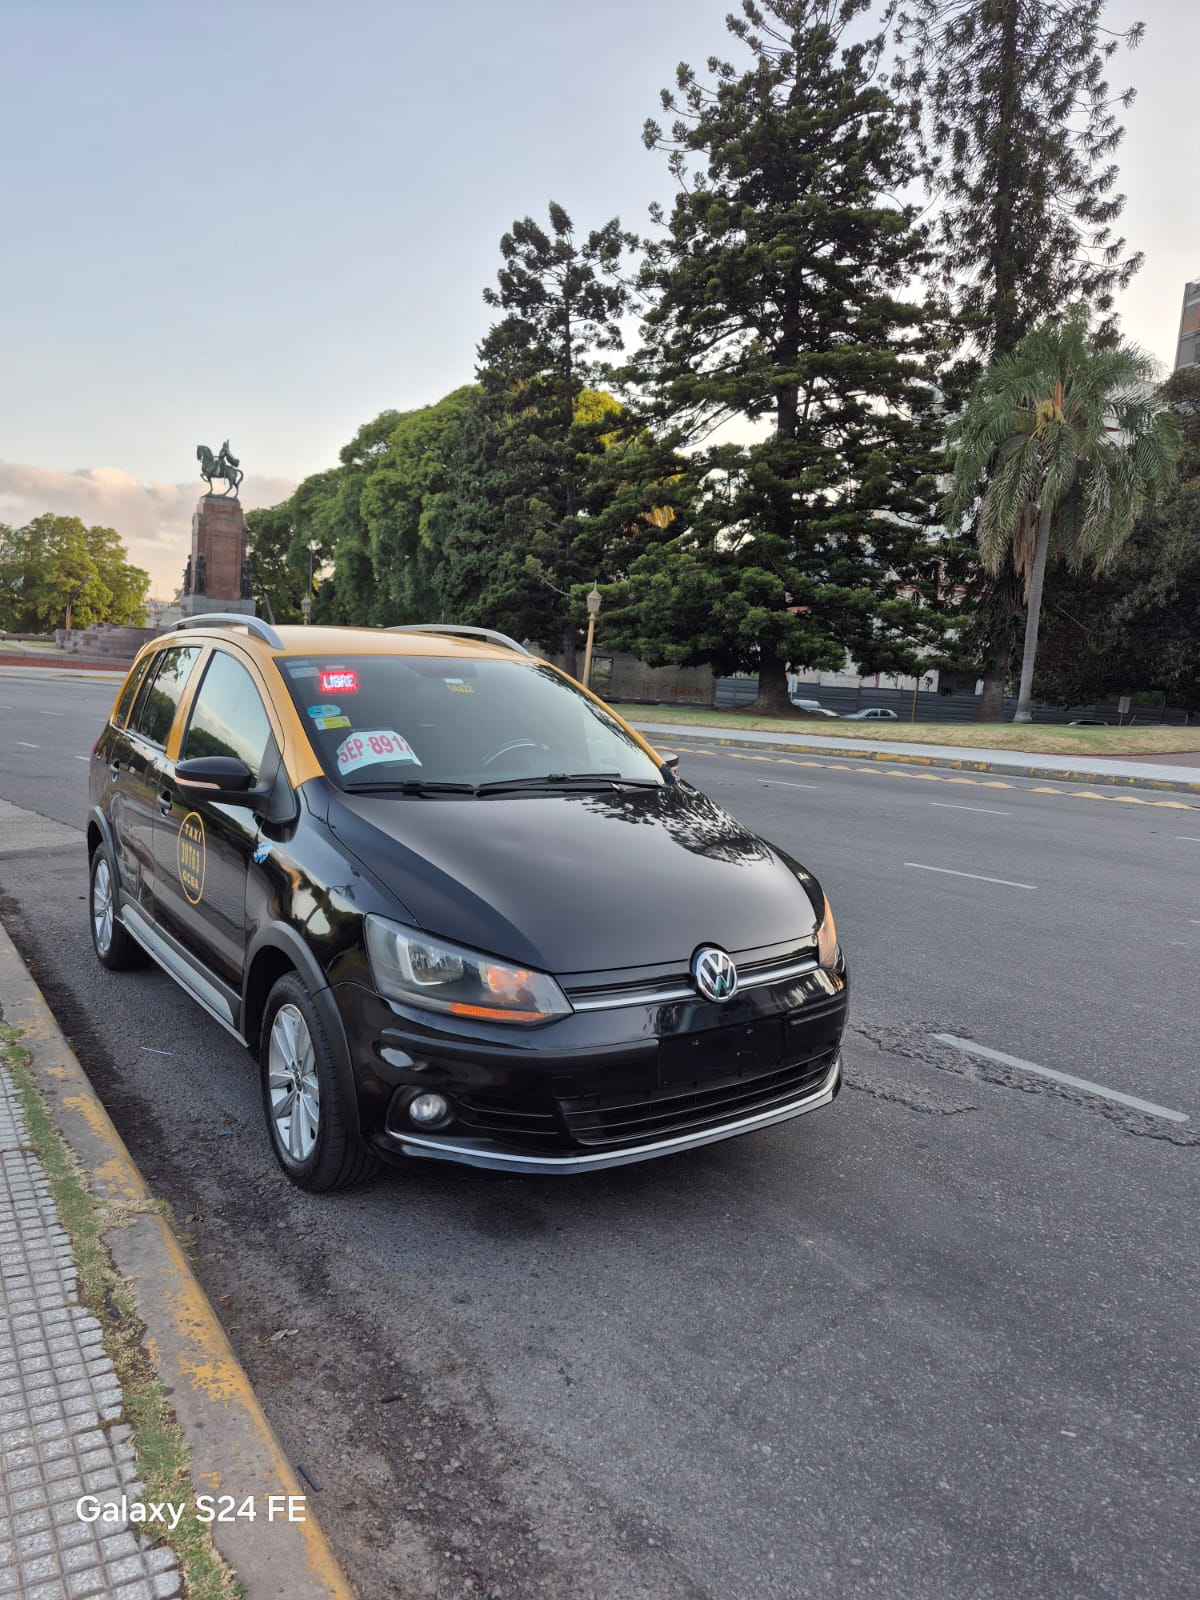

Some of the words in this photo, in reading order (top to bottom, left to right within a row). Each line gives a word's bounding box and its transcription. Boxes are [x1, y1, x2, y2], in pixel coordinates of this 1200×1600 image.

[323, 674, 354, 688] LIBRE
[185, 823, 201, 843] TAXI
[697, 949, 737, 1000] VW
